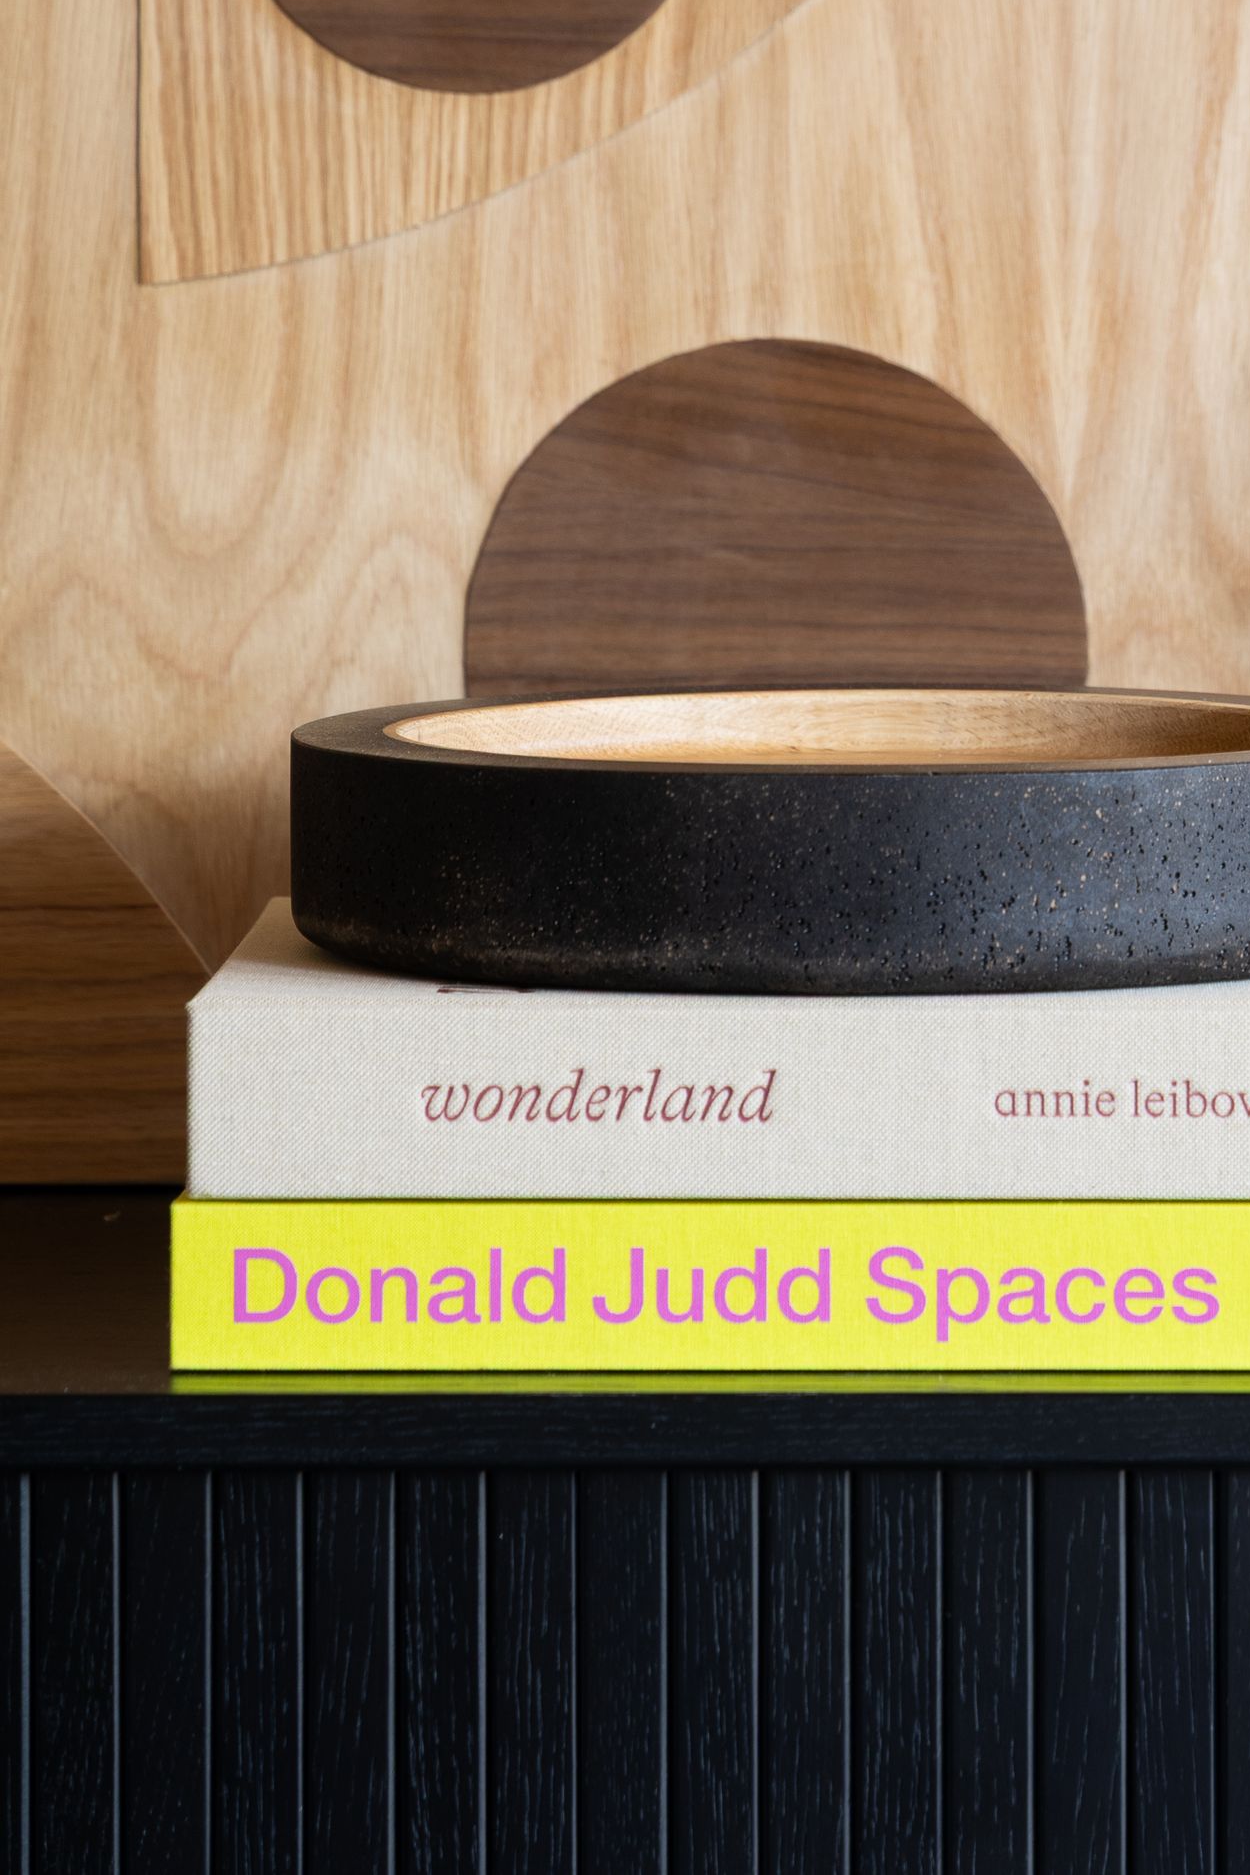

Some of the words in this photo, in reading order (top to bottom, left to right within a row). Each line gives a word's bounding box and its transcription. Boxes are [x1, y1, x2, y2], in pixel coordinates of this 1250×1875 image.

[420, 1068, 777, 1124] wonderland
[994, 1079, 1116, 1119] annie
[232, 1247, 567, 1325] Donald
[592, 1247, 831, 1325] Judd
[865, 1246, 1220, 1342] Spaces
